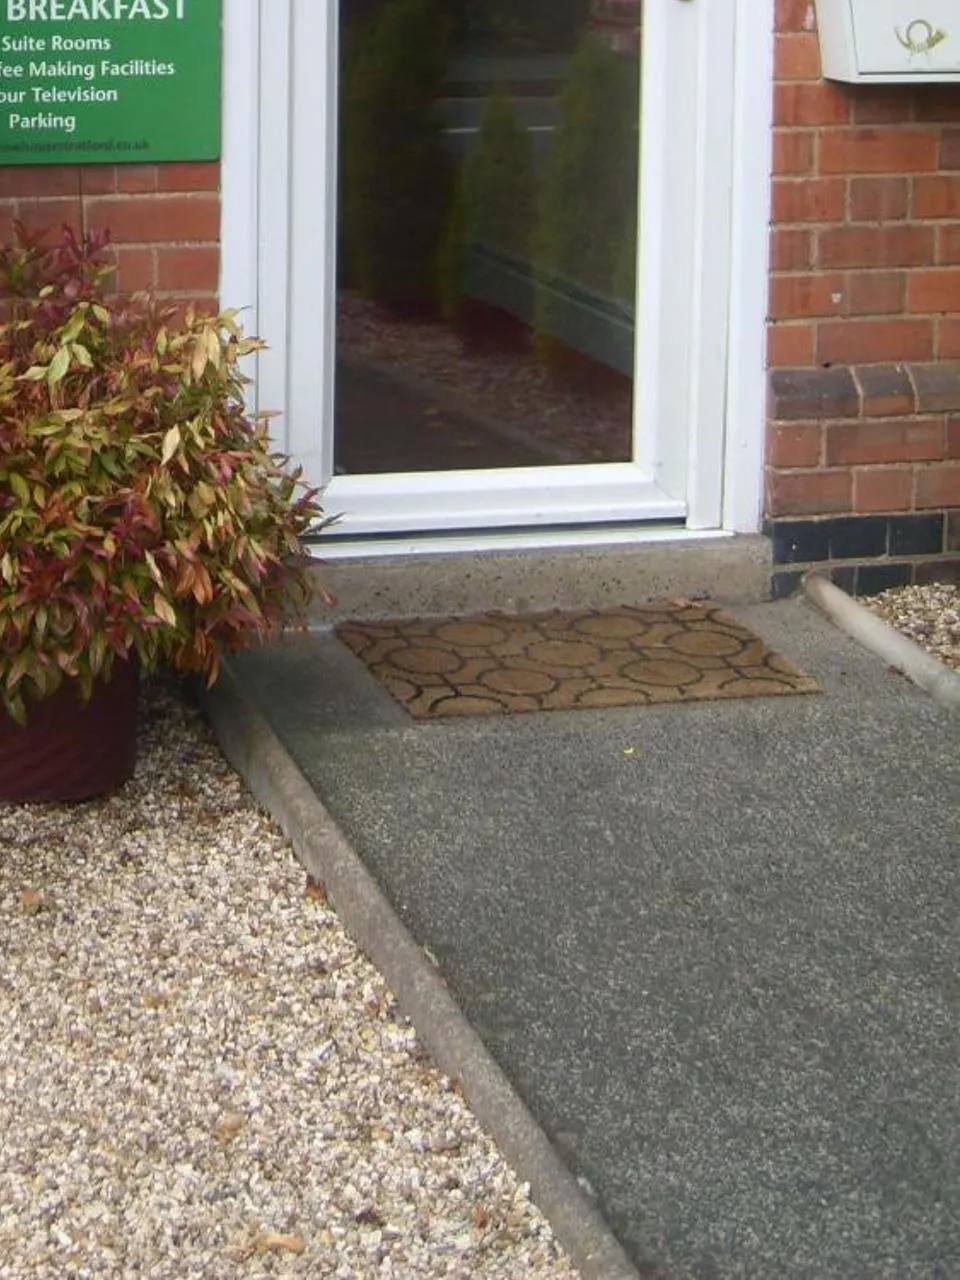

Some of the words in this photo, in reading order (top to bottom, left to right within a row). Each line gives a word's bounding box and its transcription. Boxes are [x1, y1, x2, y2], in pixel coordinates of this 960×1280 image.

[2, 35, 46, 52] Suite
[52, 34, 111, 51] Rooms
[29, 60, 95, 80] Making
[101, 59, 176, 76] Facilities
[32, 85, 118, 103] Television
[9, 112, 77, 132] Parking
